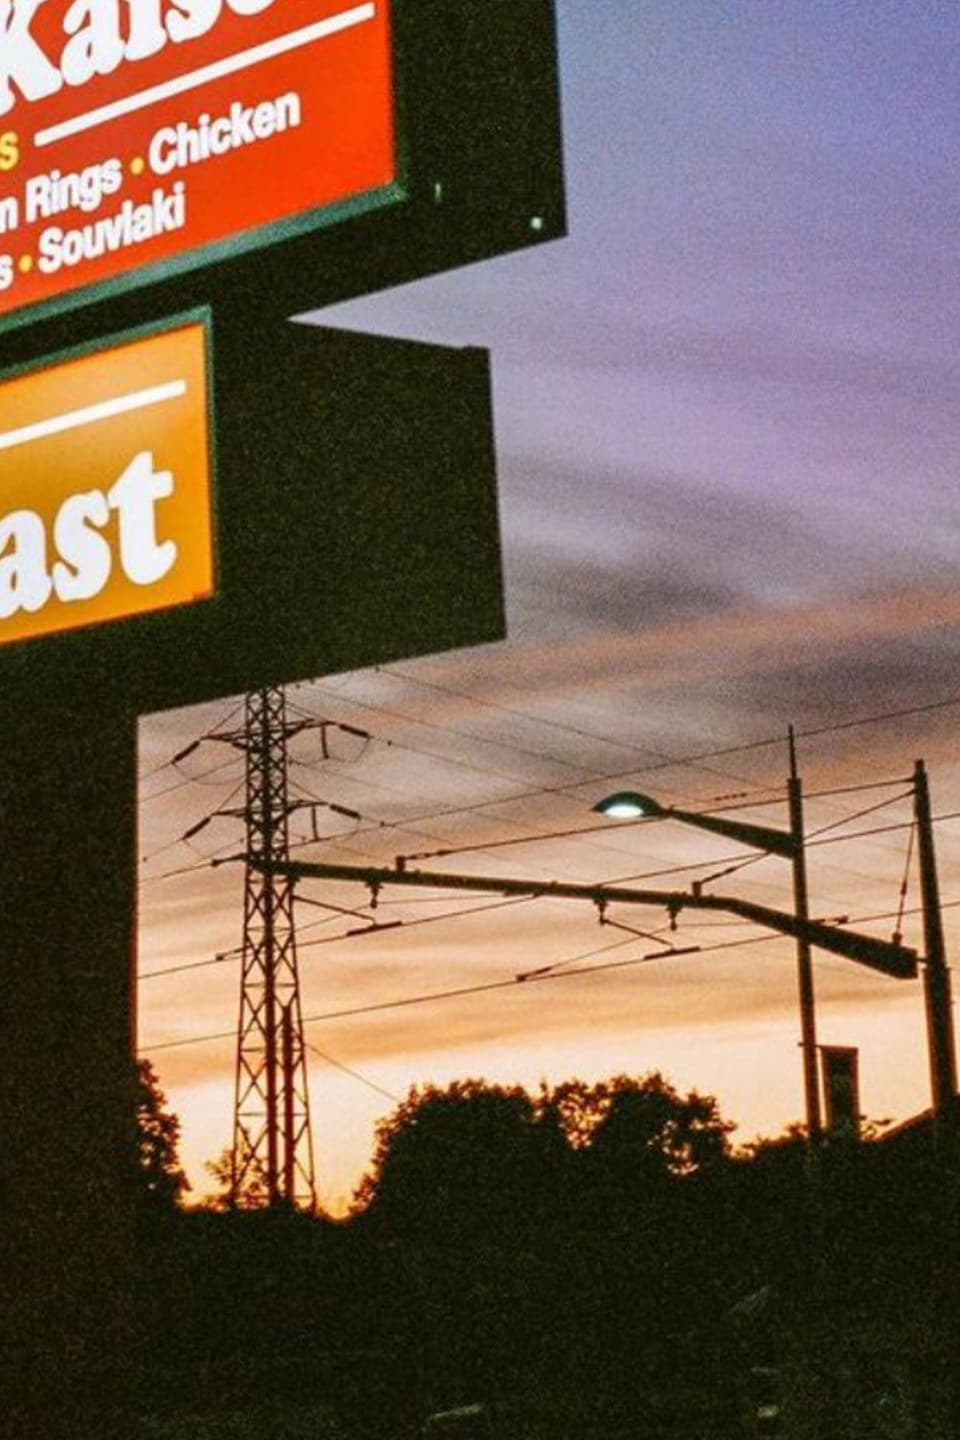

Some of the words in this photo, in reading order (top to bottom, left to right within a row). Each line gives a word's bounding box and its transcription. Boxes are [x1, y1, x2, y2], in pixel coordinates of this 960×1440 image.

[25, 158, 122, 223] Rings
[148, 92, 301, 175] Chicken
[38, 180, 186, 274] Souvlaki
